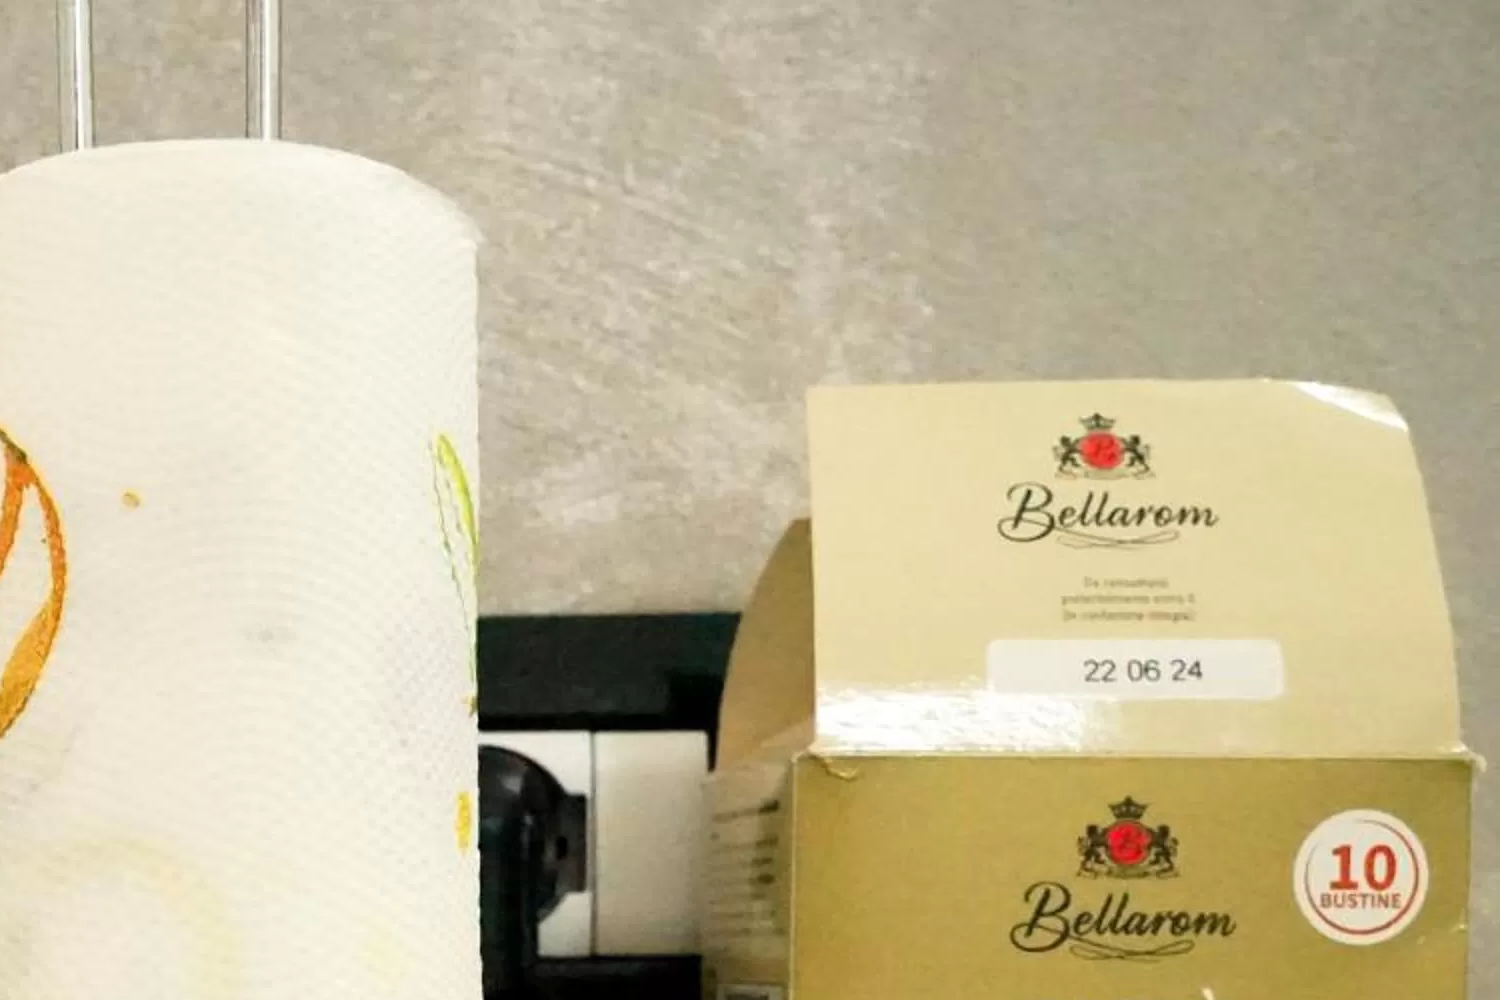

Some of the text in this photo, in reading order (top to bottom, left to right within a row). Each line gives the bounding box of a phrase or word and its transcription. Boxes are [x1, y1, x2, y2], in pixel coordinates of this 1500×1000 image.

[998, 481, 1219, 549] Bellarom
[1083, 657, 1203, 683] 22 06 24
[1329, 843, 1397, 891] 10
[1009, 881, 1237, 960] Bellarom
[1320, 892, 1402, 909] BUSTINE
